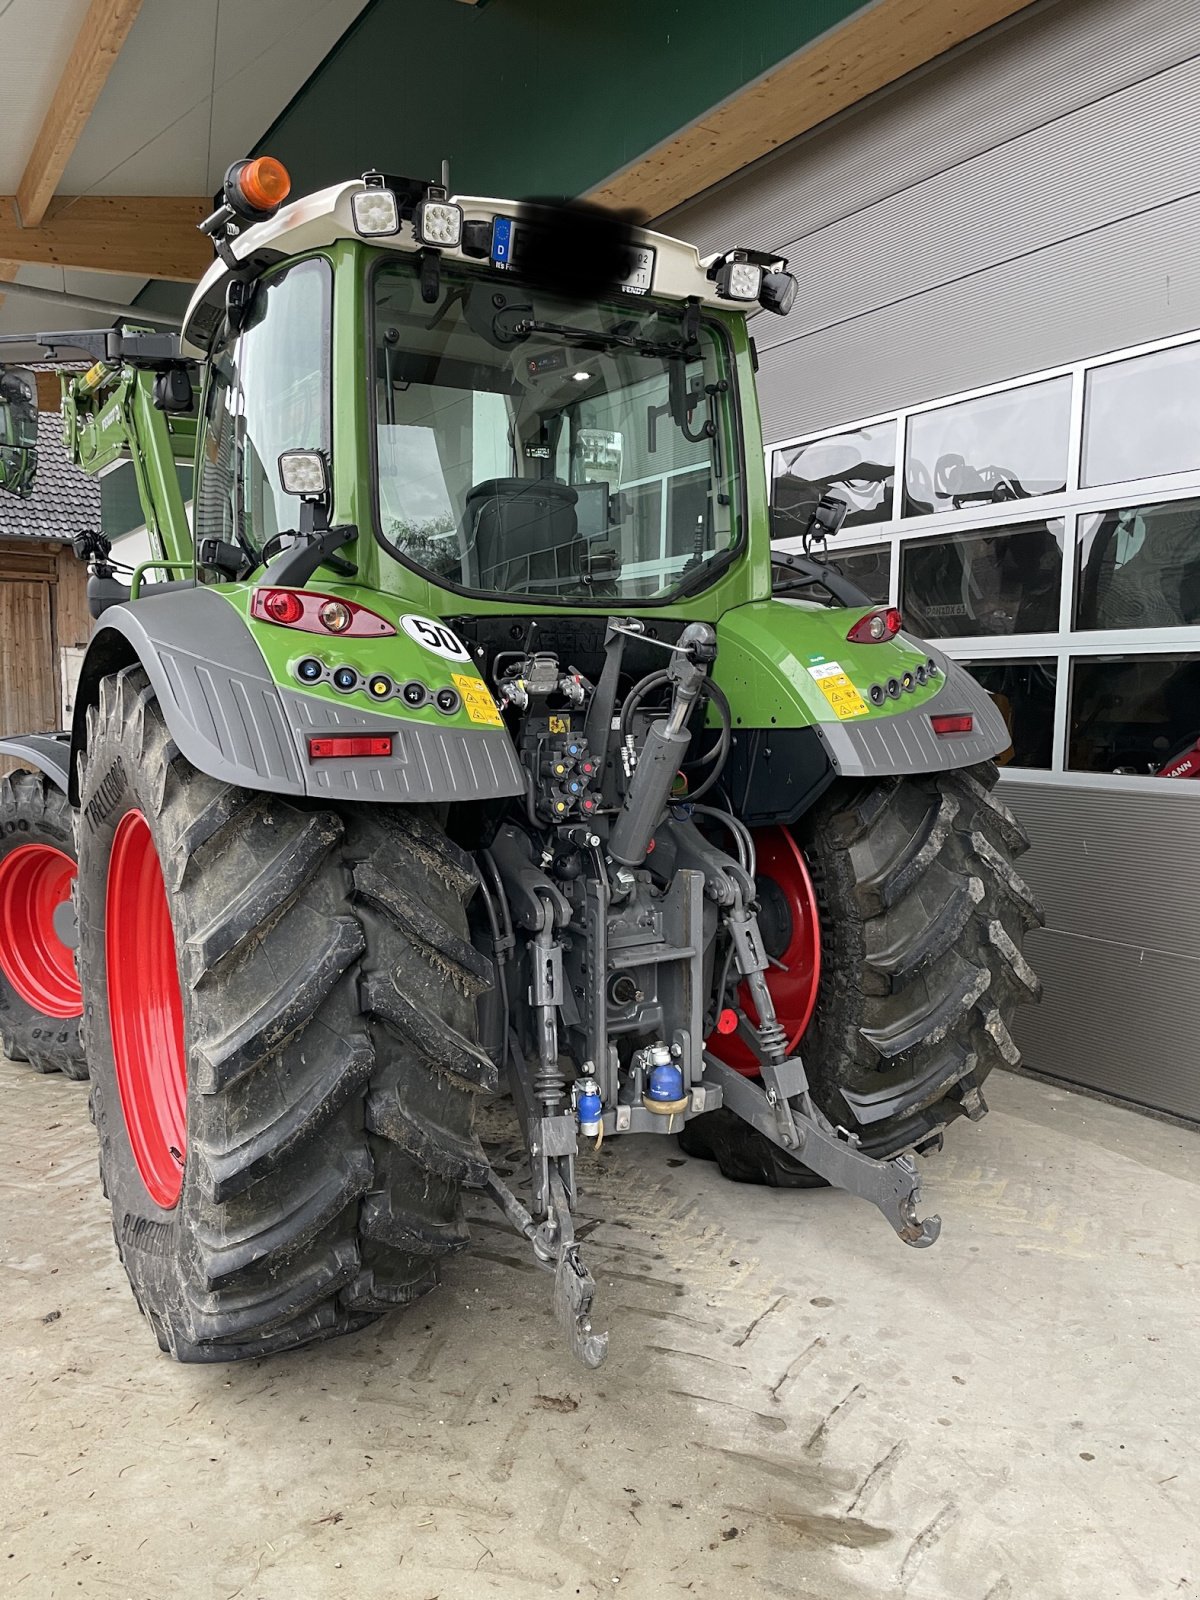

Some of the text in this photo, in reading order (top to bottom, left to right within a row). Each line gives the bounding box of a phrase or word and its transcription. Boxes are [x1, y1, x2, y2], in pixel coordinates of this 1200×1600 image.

[497, 245, 504, 255] D
[638, 253, 648, 264] 02
[621, 285, 647, 296] FENDT
[411, 618, 462, 654] 50
[84, 755, 129, 834] TRELLEBORG
